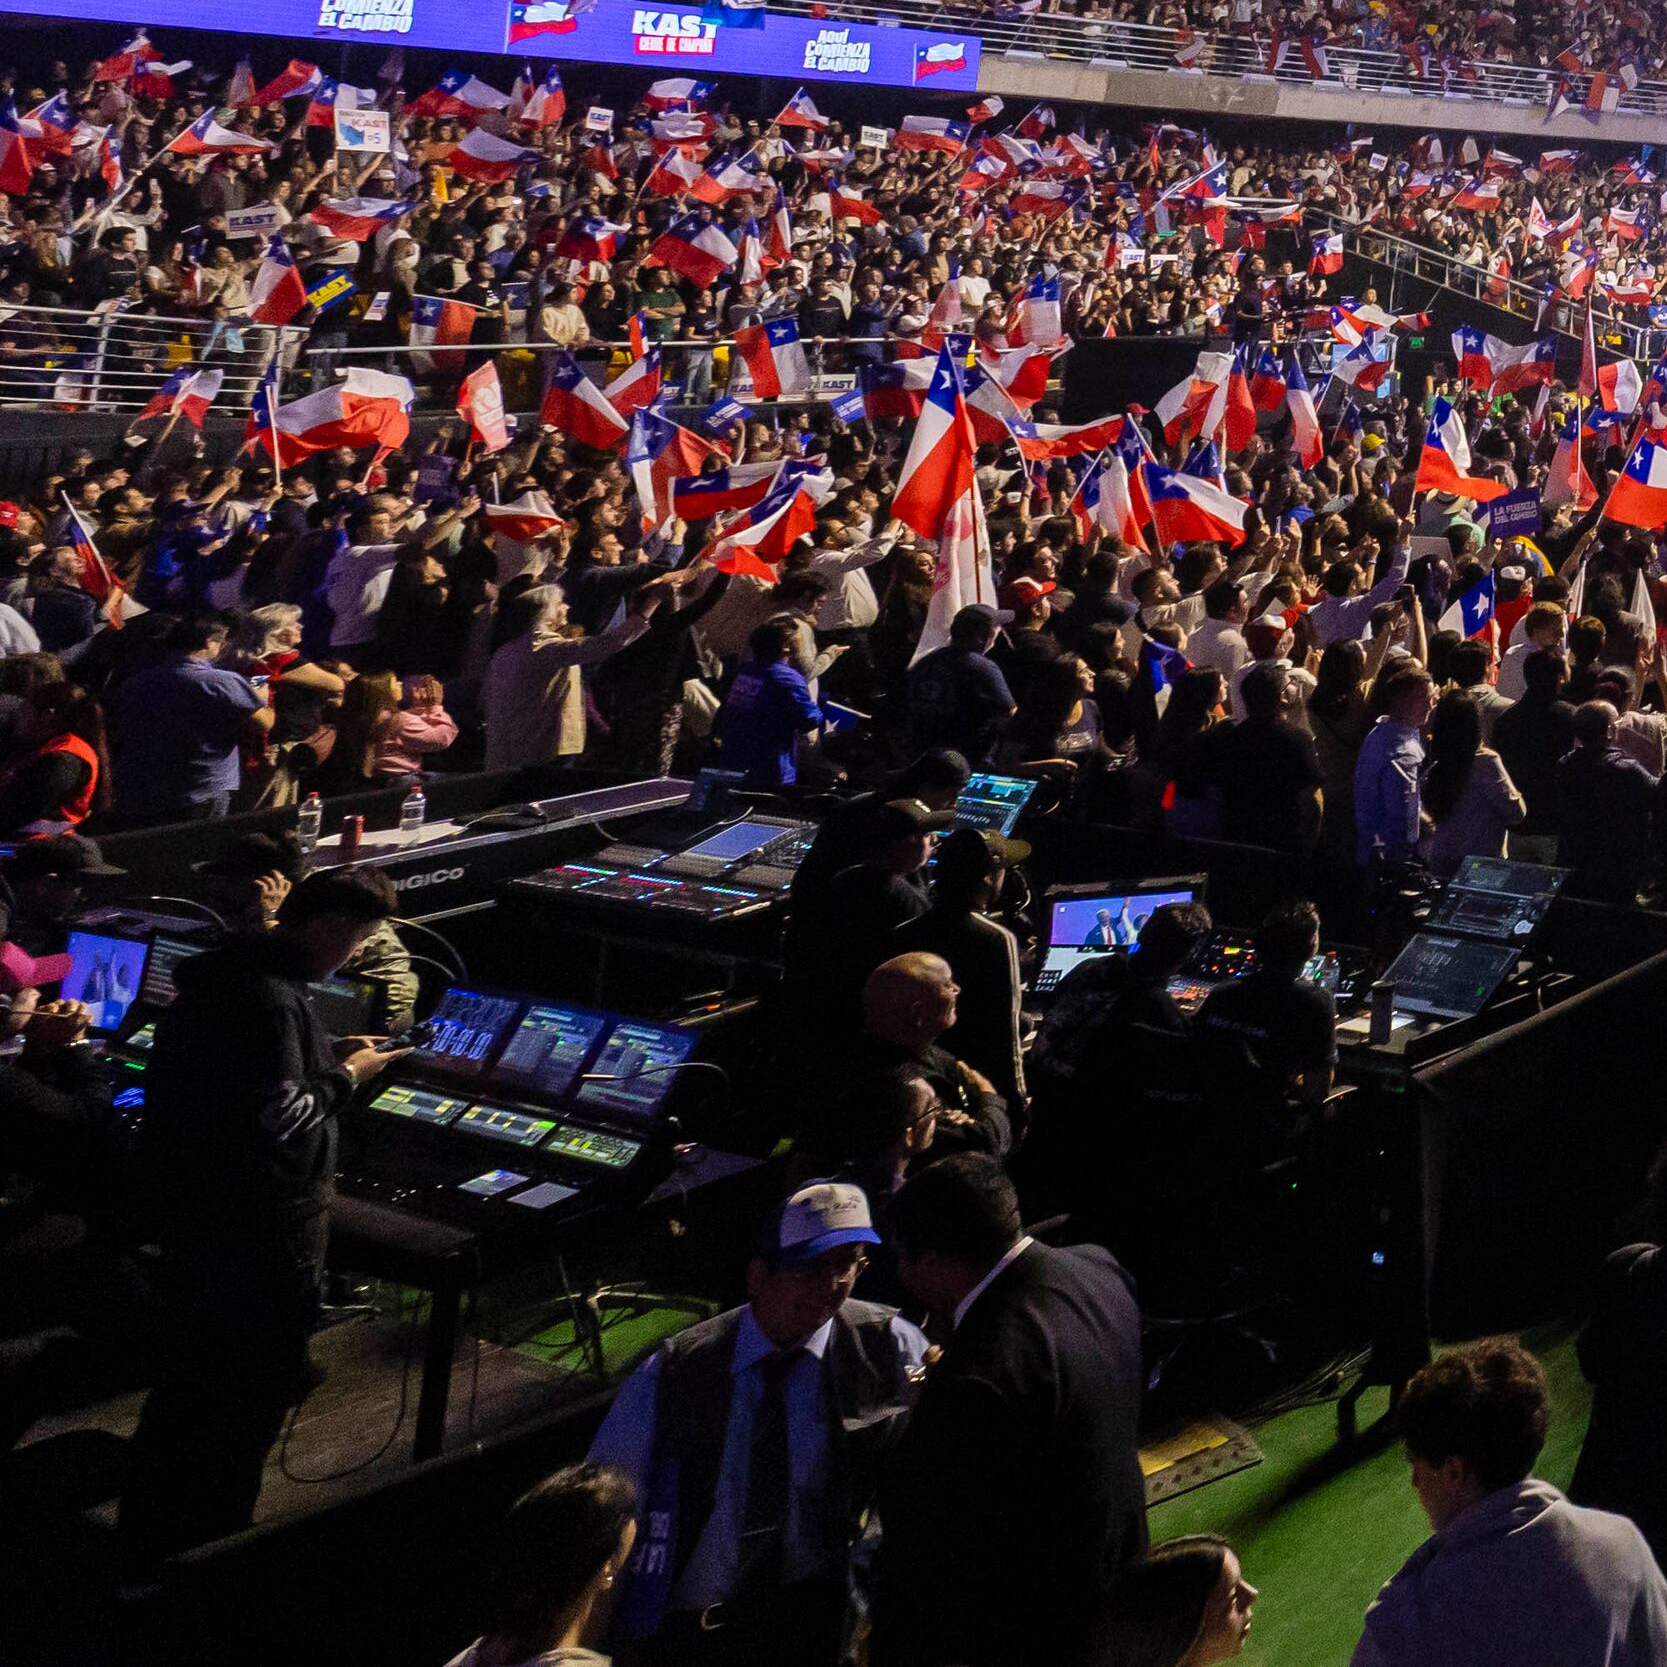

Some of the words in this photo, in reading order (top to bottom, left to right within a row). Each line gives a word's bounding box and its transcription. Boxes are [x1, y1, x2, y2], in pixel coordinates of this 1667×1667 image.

[319, 12, 336, 26] EL
[632, 10, 717, 39] KAST
[803, 56, 816, 68] EL
[730, 384, 754, 393] KAS
[1494, 507, 1504, 516] LA
[1505, 501, 1537, 514] FUERZA
[1494, 516, 1509, 525] DEL
